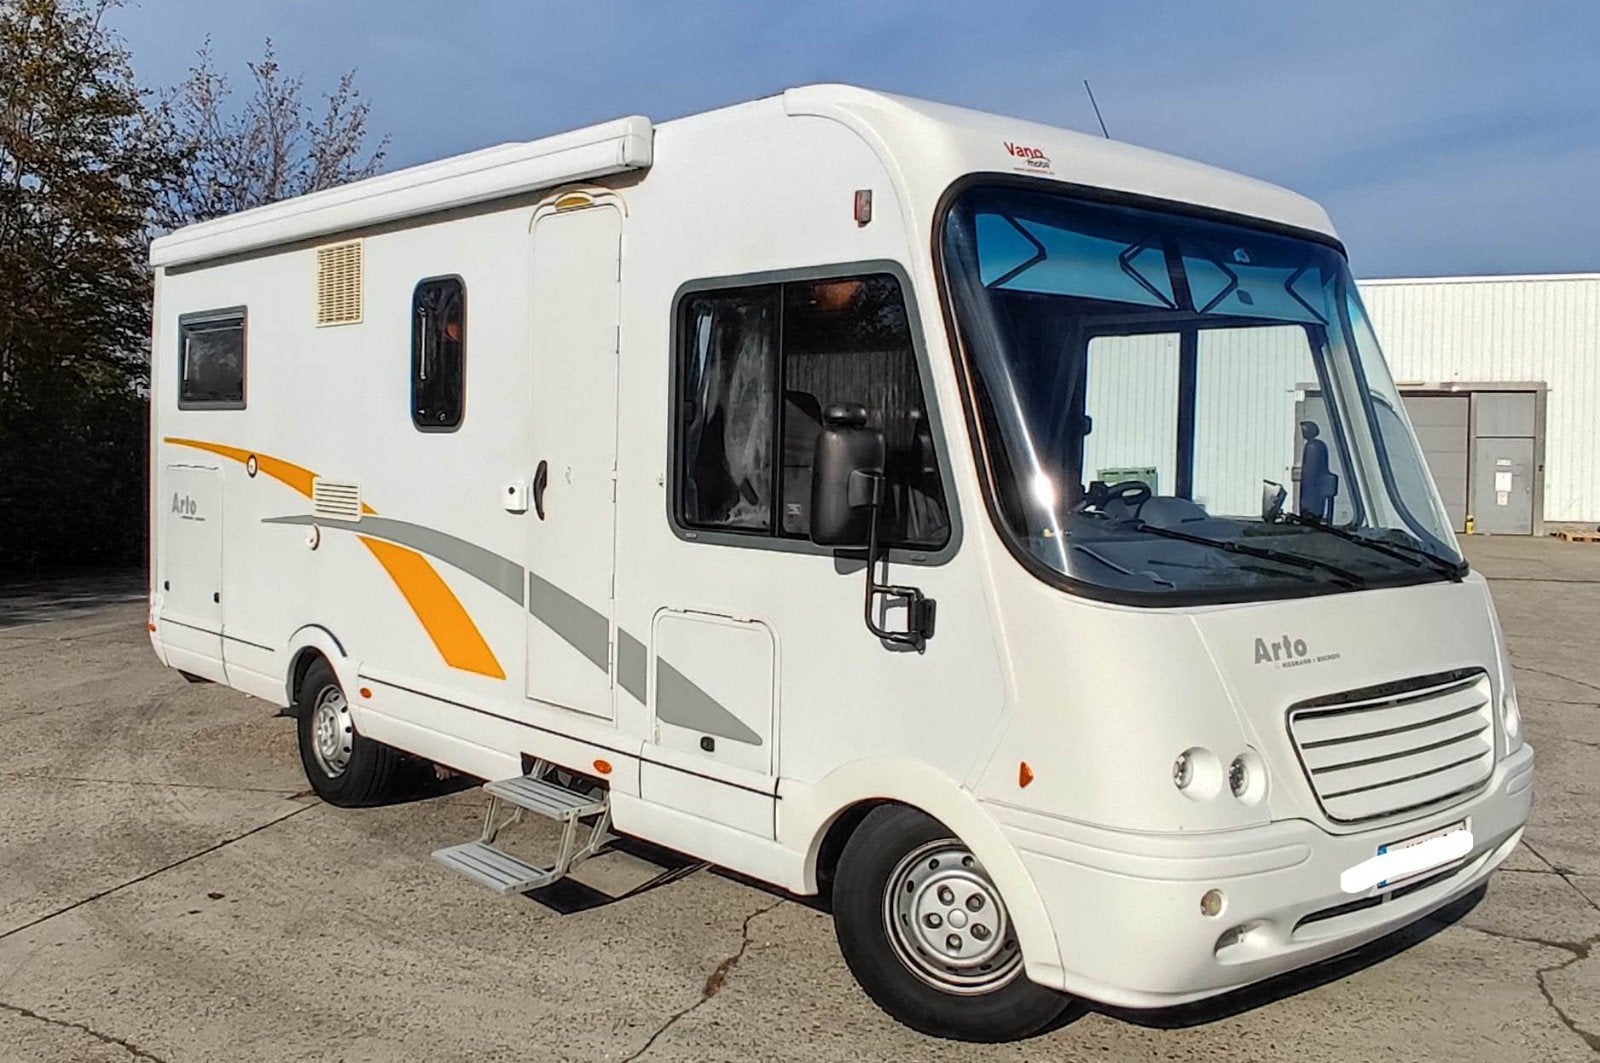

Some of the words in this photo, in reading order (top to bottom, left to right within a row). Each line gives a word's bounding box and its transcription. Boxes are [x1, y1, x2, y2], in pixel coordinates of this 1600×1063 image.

[1003, 141, 1044, 159] Vano
[172, 492, 197, 515] Arto
[1255, 635, 1307, 664] Arto
